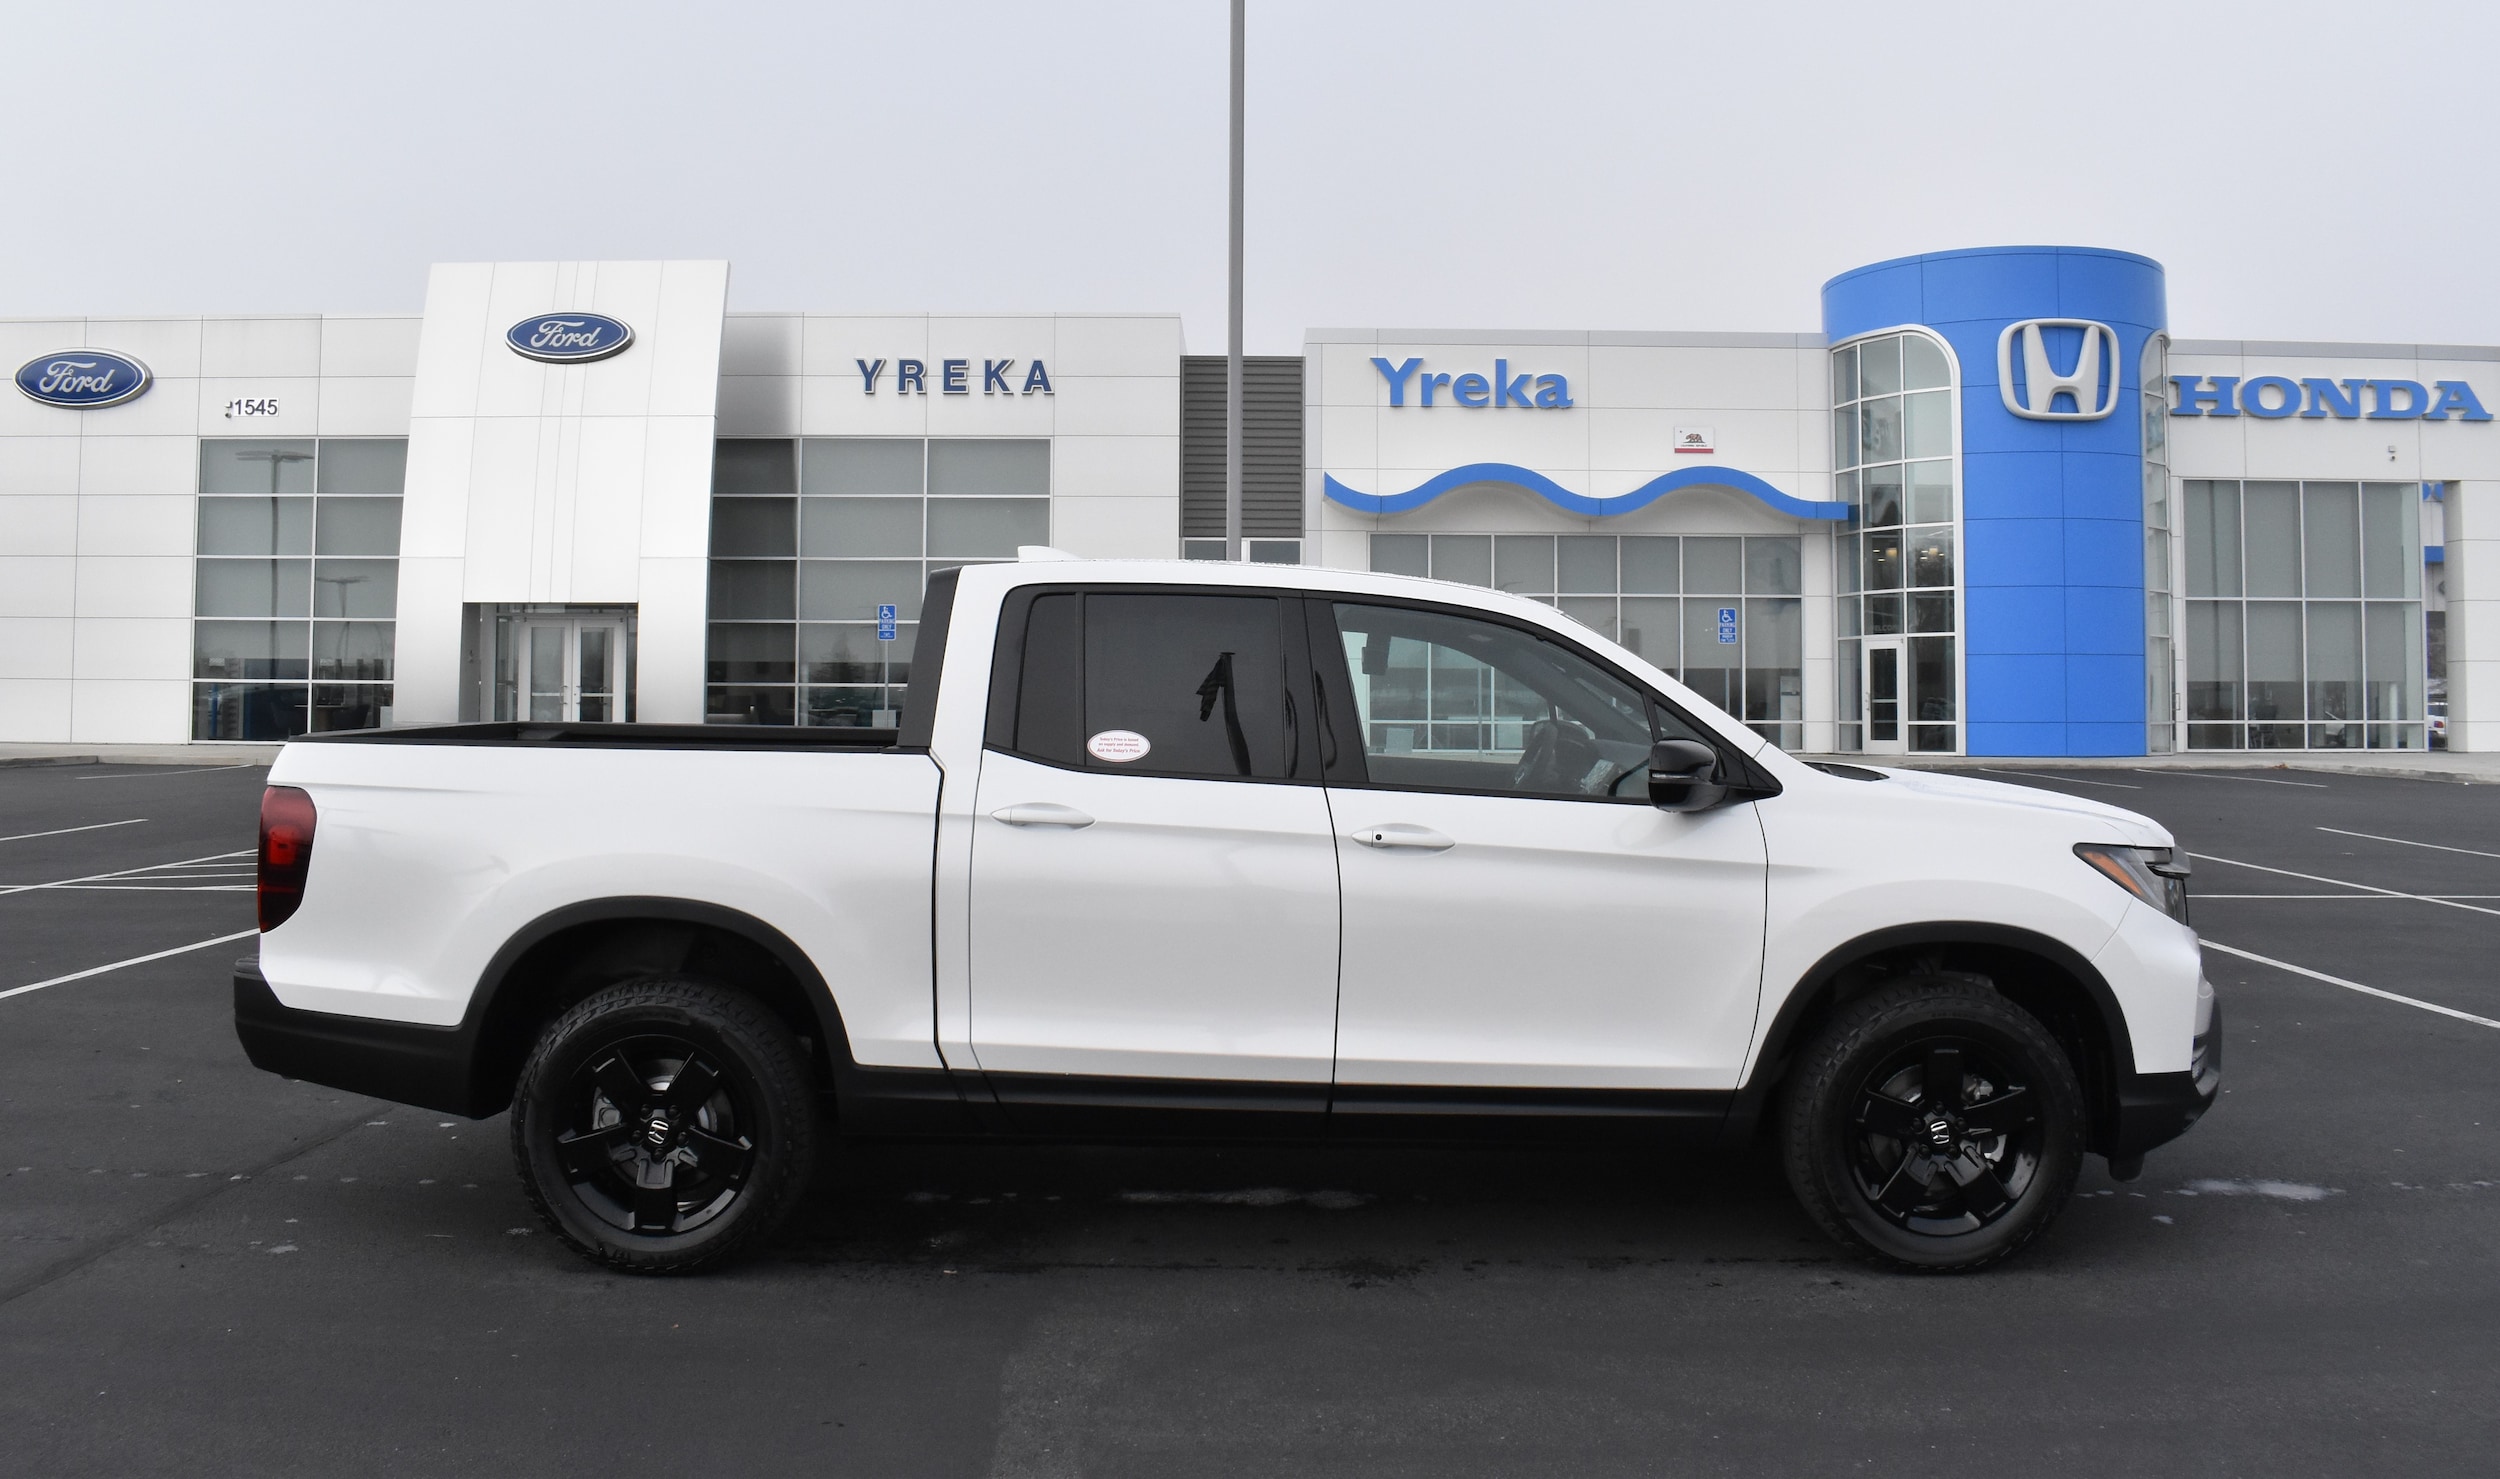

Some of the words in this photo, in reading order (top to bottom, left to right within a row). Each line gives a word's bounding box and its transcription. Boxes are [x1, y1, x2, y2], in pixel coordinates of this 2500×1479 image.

[530, 320, 602, 348] Ford
[39, 360, 116, 393] Ford
[855, 357, 1054, 395] YREKA
[1369, 356, 1574, 409] Yreka
[235, 399, 278, 415] 1545
[2169, 375, 2494, 421] HONDA
